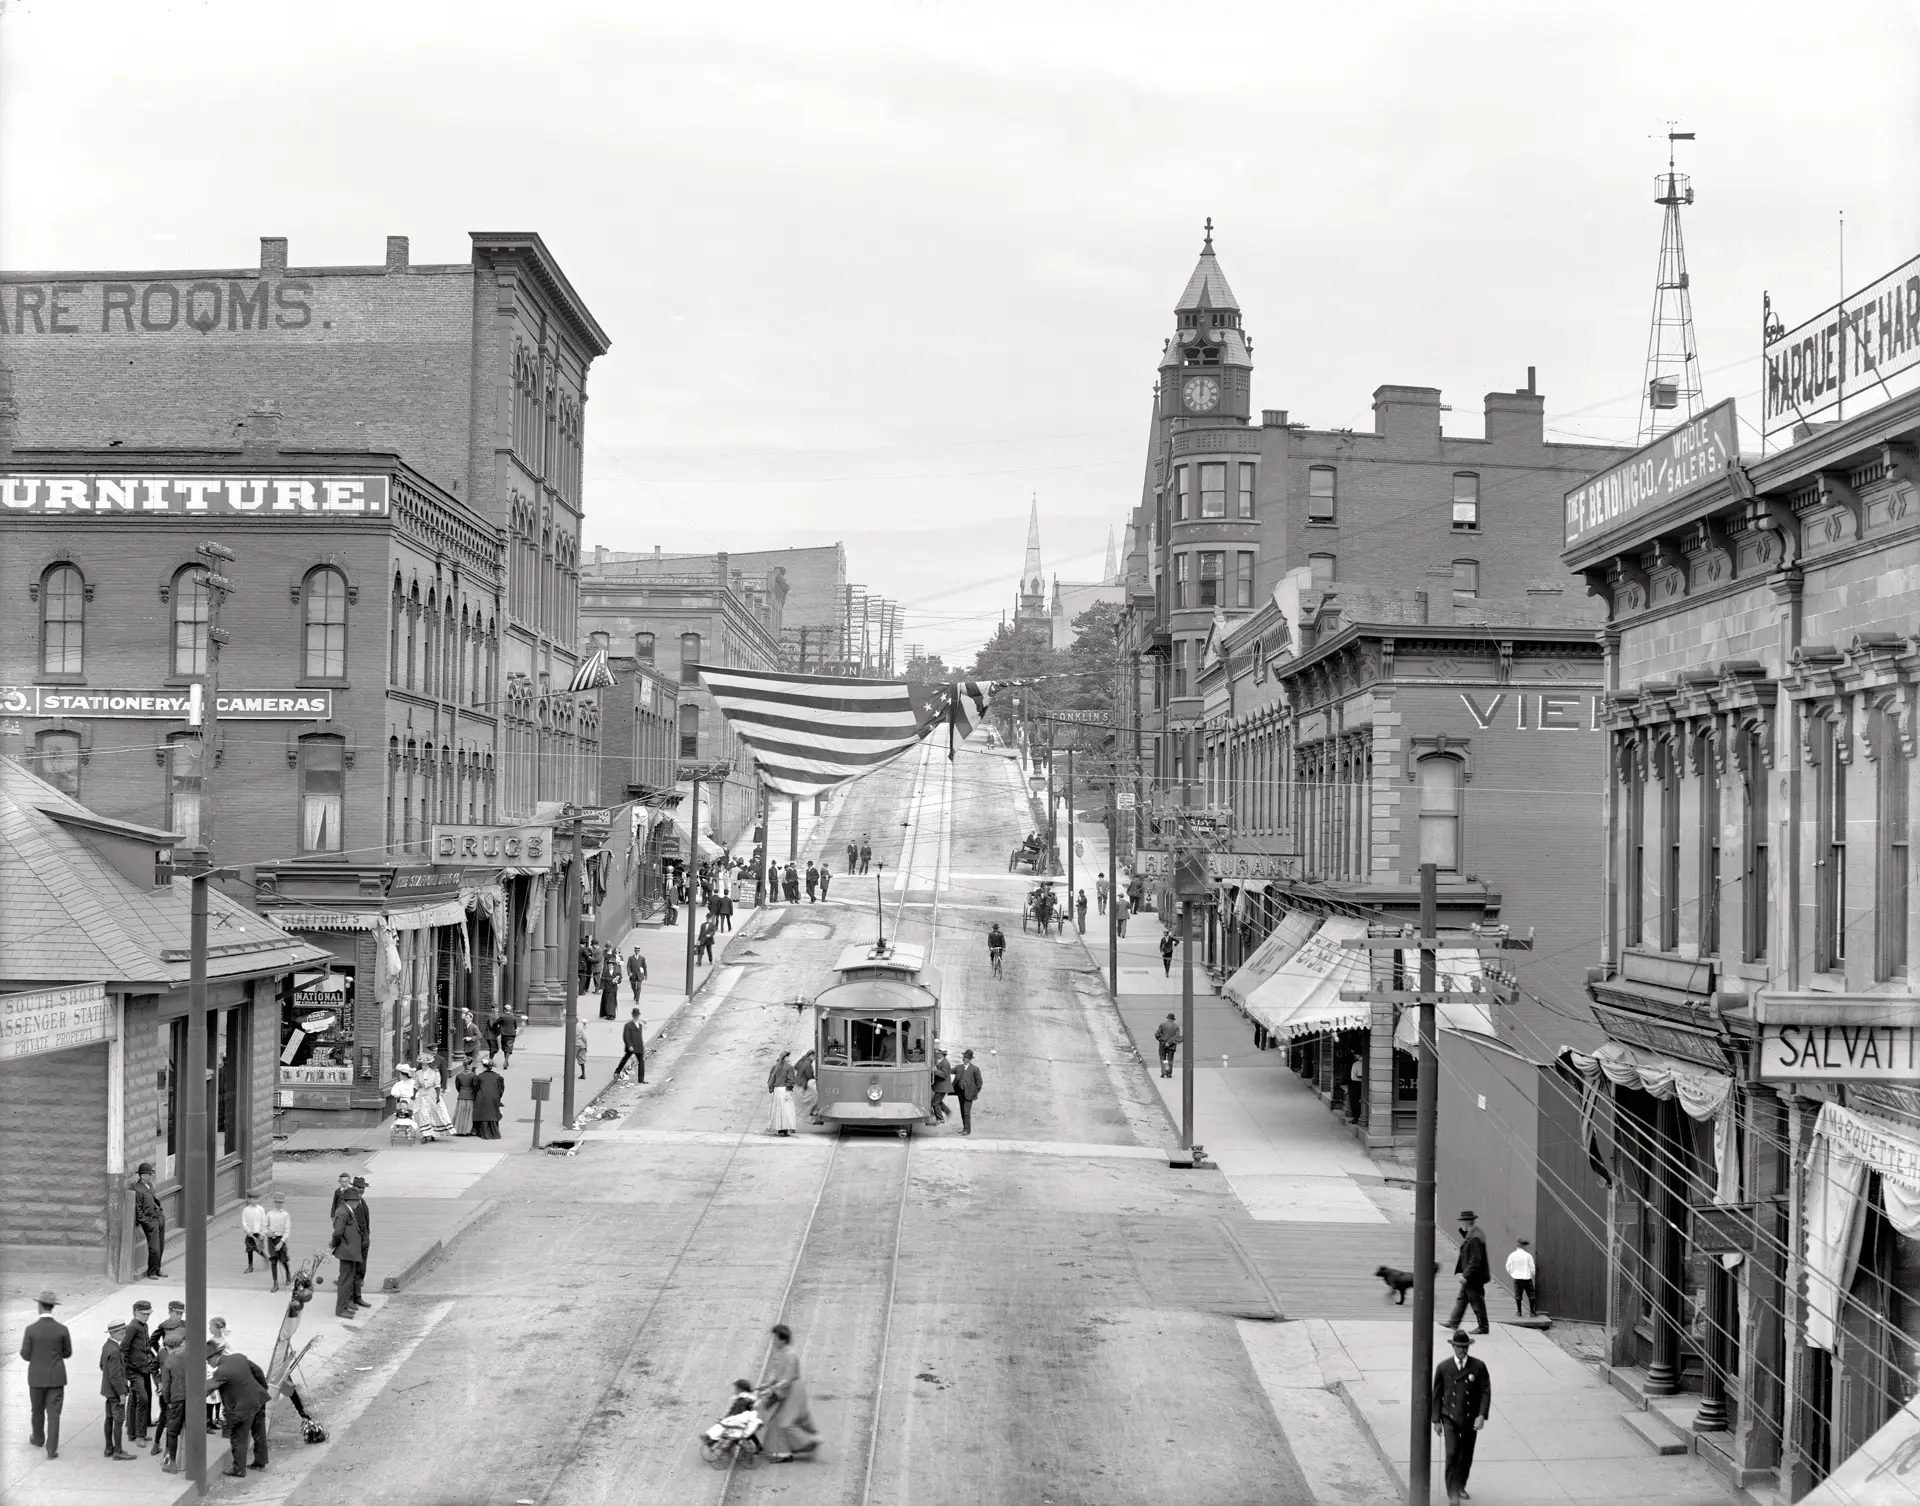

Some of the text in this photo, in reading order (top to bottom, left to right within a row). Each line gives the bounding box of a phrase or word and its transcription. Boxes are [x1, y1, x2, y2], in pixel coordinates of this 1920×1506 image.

[102, 280, 332, 335] ROOMS.
[1767, 298, 1877, 421] MARQUETTE
[1673, 418, 1708, 459] WHOLE
[1667, 447, 1722, 494] SALERS.
[1567, 493, 1579, 524] THE
[44, 695, 183, 711] STATIONERY
[216, 698, 325, 712] CAMERAS
[440, 835, 543, 858] DRUGS
[1146, 853, 1295, 877] REAURANT
[5, 986, 105, 1015] SOUTH SHORE
[296, 992, 343, 1001] NATIONAL
[14, 1036, 50, 1054] PRIVATE
[1829, 1105, 1908, 1177] MARQUETTE
